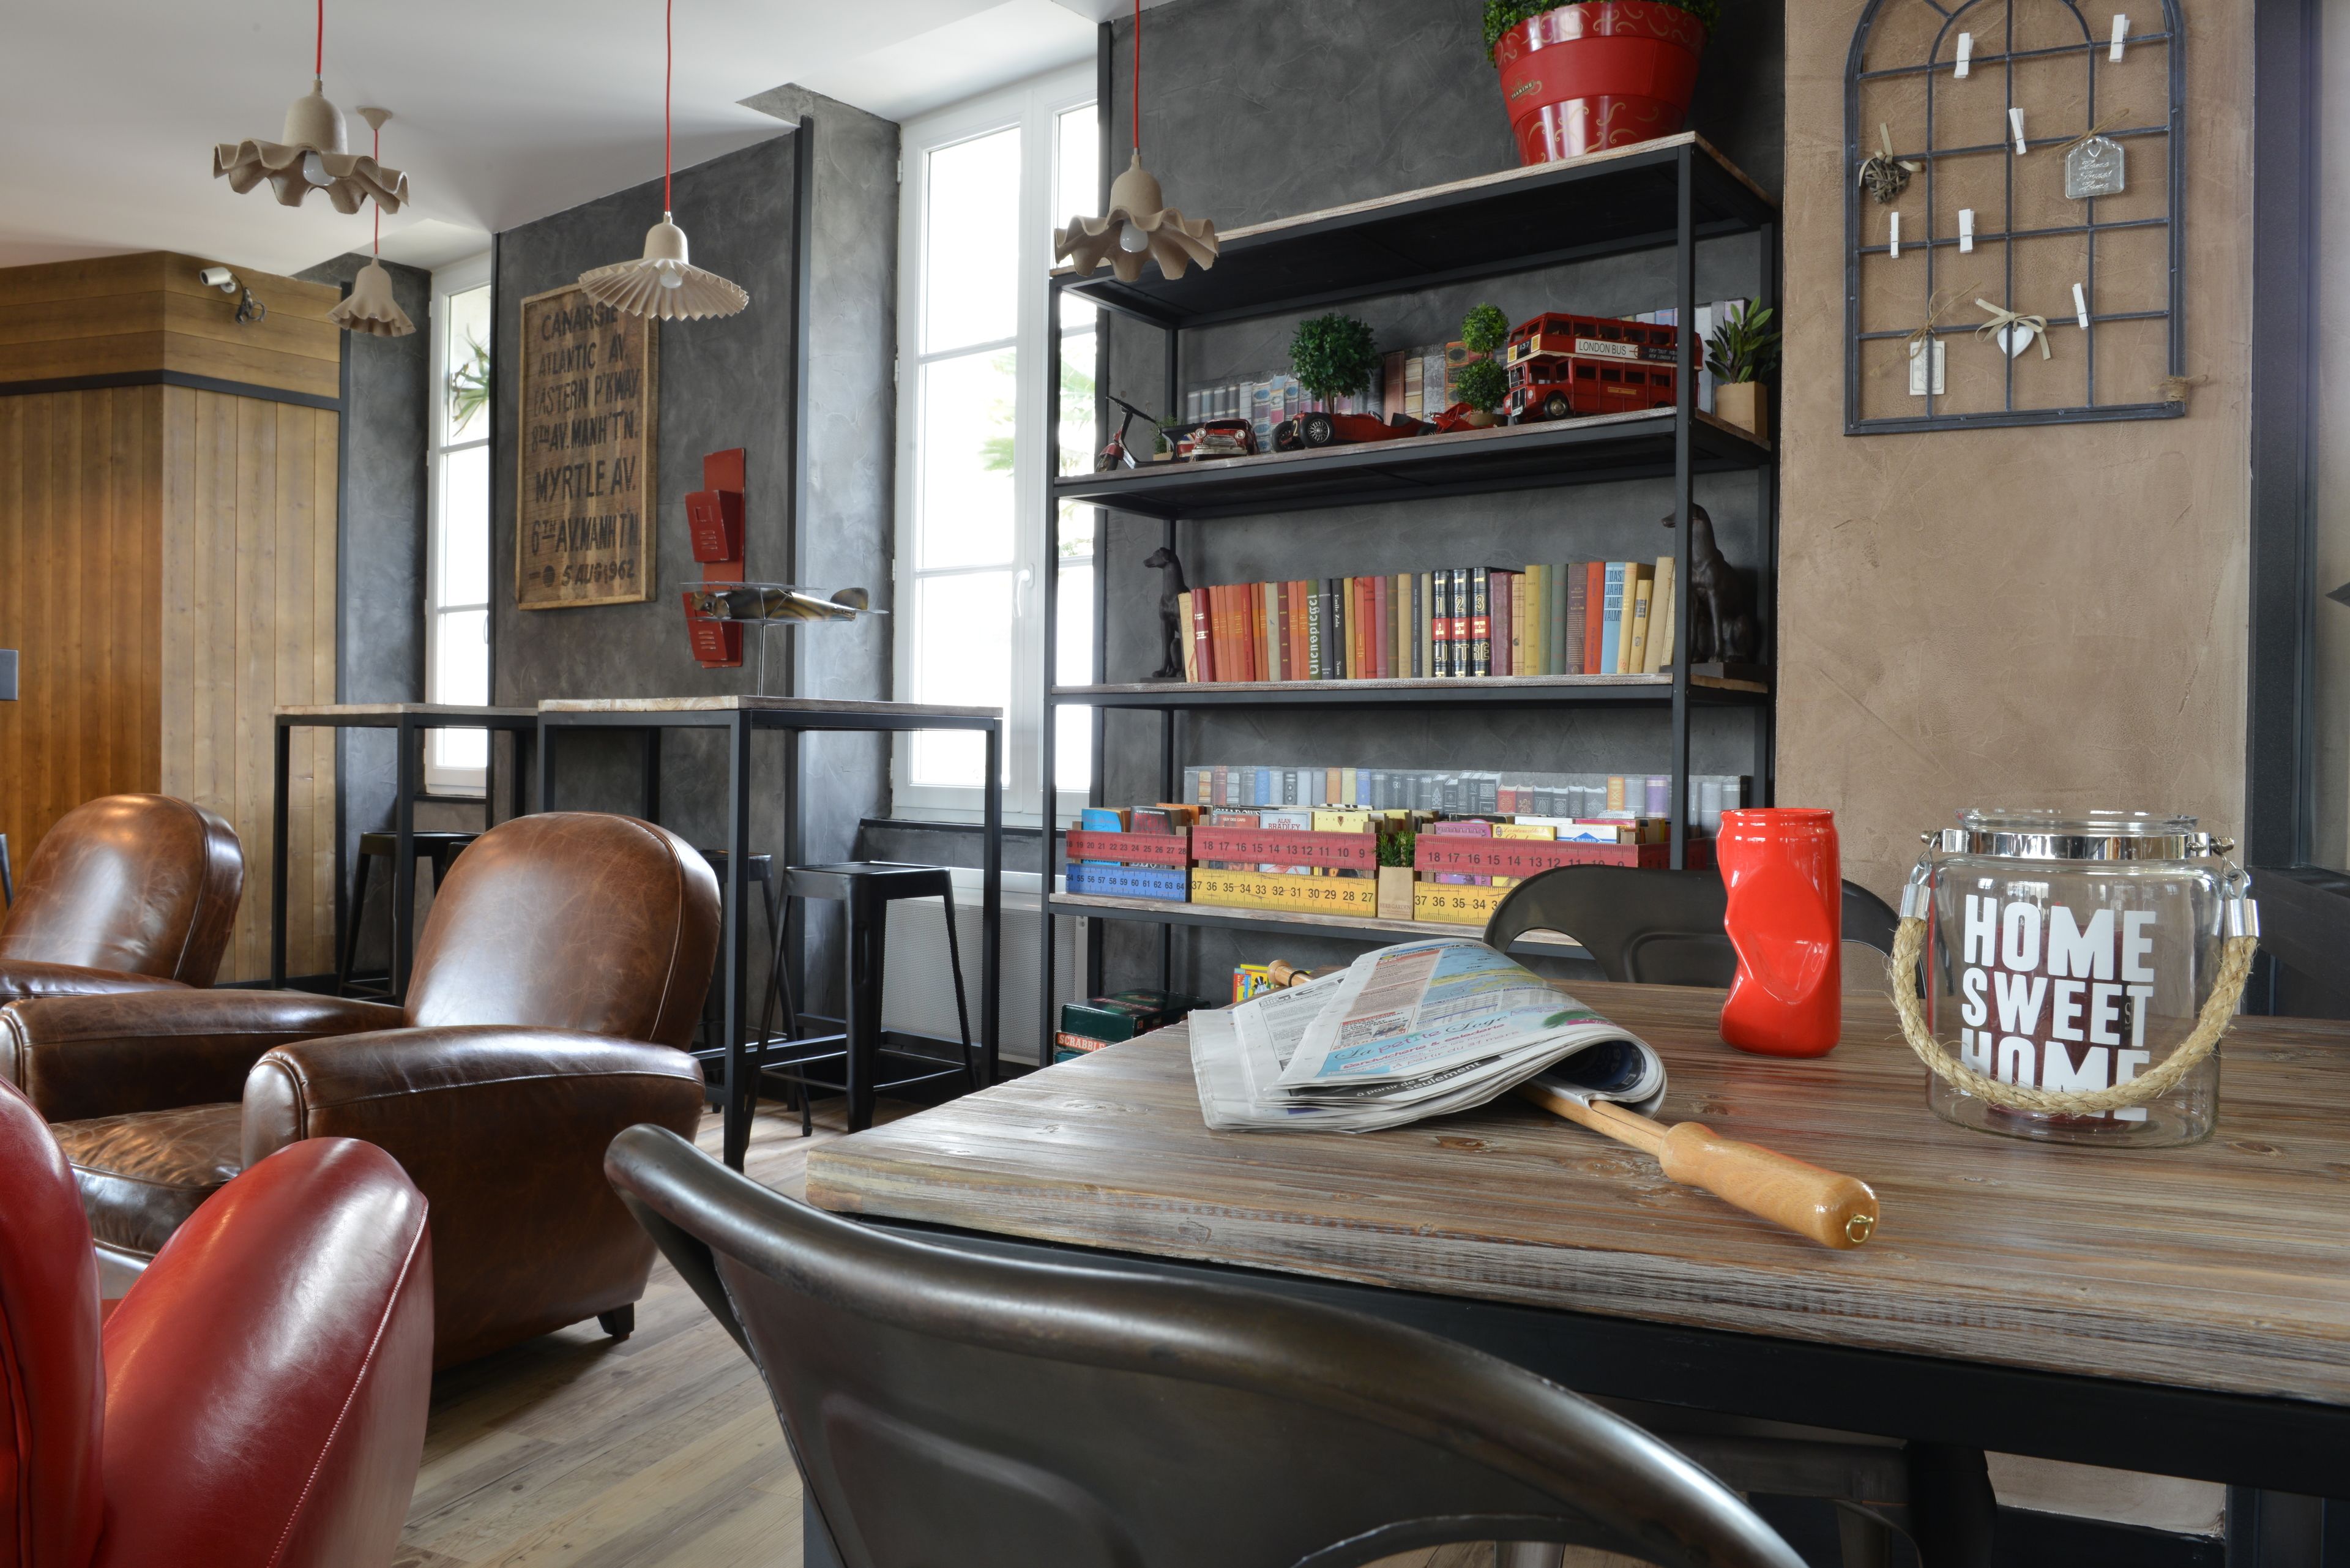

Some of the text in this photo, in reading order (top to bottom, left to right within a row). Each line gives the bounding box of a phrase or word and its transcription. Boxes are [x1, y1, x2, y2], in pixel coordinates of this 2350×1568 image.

[542, 302, 618, 341] CANARSIE
[1520, 341, 1529, 350] 137
[1579, 342, 1627, 355] LONDON BUS
[539, 342, 597, 377] ATLANTIC
[534, 378, 589, 417] EASTERN
[1293, 420, 1298, 436] 2
[535, 460, 606, 503] MYRTLE
[531, 519, 556, 556] 6TH
[561, 565, 573, 586] 5
[1610, 570, 1622, 581] DAS
[1606, 583, 1622, 595] JAHR
[1437, 597, 1442, 613] 1
[1455, 596, 1464, 612] 2
[1476, 594, 1484, 611] 3
[1608, 597, 1620, 608] AUF
[1203, 842, 1365, 858] 18 17 16 15 14 13 12 11 10 9
[1428, 852, 1440, 862] 18
[1448, 853, 1460, 862] 17
[1468, 854, 1480, 864] 16
[1488, 855, 1500, 865] 15
[1508, 856, 1520, 865] 14
[1530, 857, 1542, 867] 13
[1548, 858, 1559, 867] 12
[1192, 881, 1373, 902] 37 36 35 34 33 32 31 30 29 28 27
[1415, 896, 1427, 905] 37
[1433, 897, 1445, 906] 36
[1453, 898, 1465, 908] 35
[1473, 899, 1485, 909] 34
[1964, 894, 2156, 982] HOME
[1962, 968, 2154, 1047] SWEET
[1059, 1034, 1106, 1051] SCRABBLE
[1335, 1047, 1374, 1060] La
[1378, 1031, 1441, 1053] petite
[1444, 1016, 1508, 1035] Loge
[1408, 1051, 1444, 1065] partir
[1486, 1031, 1519, 1042] mars
[1405, 1061, 1482, 1090] seulement
[1961, 1028, 2150, 1121] HOME
[1367, 1084, 1398, 1096] partir
